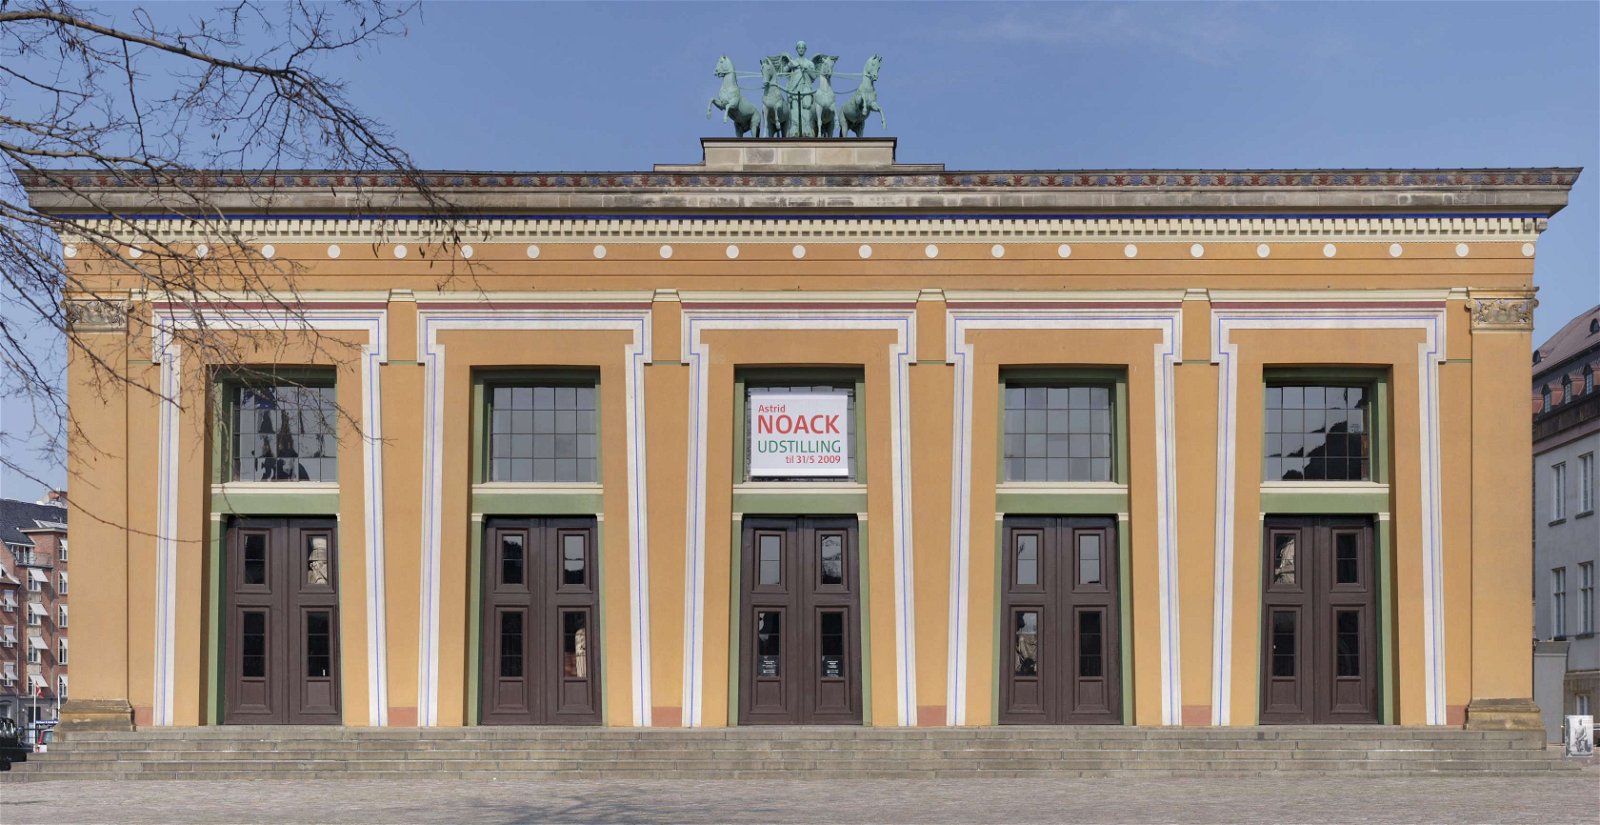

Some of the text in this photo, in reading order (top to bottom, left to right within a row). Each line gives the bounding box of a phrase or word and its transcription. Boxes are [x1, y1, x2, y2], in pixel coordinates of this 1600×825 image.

[758, 404, 786, 413] Astrid
[757, 414, 840, 434] NOACK
[758, 440, 841, 453] UDSTILLING
[785, 455, 841, 464] til 31/5 2009
